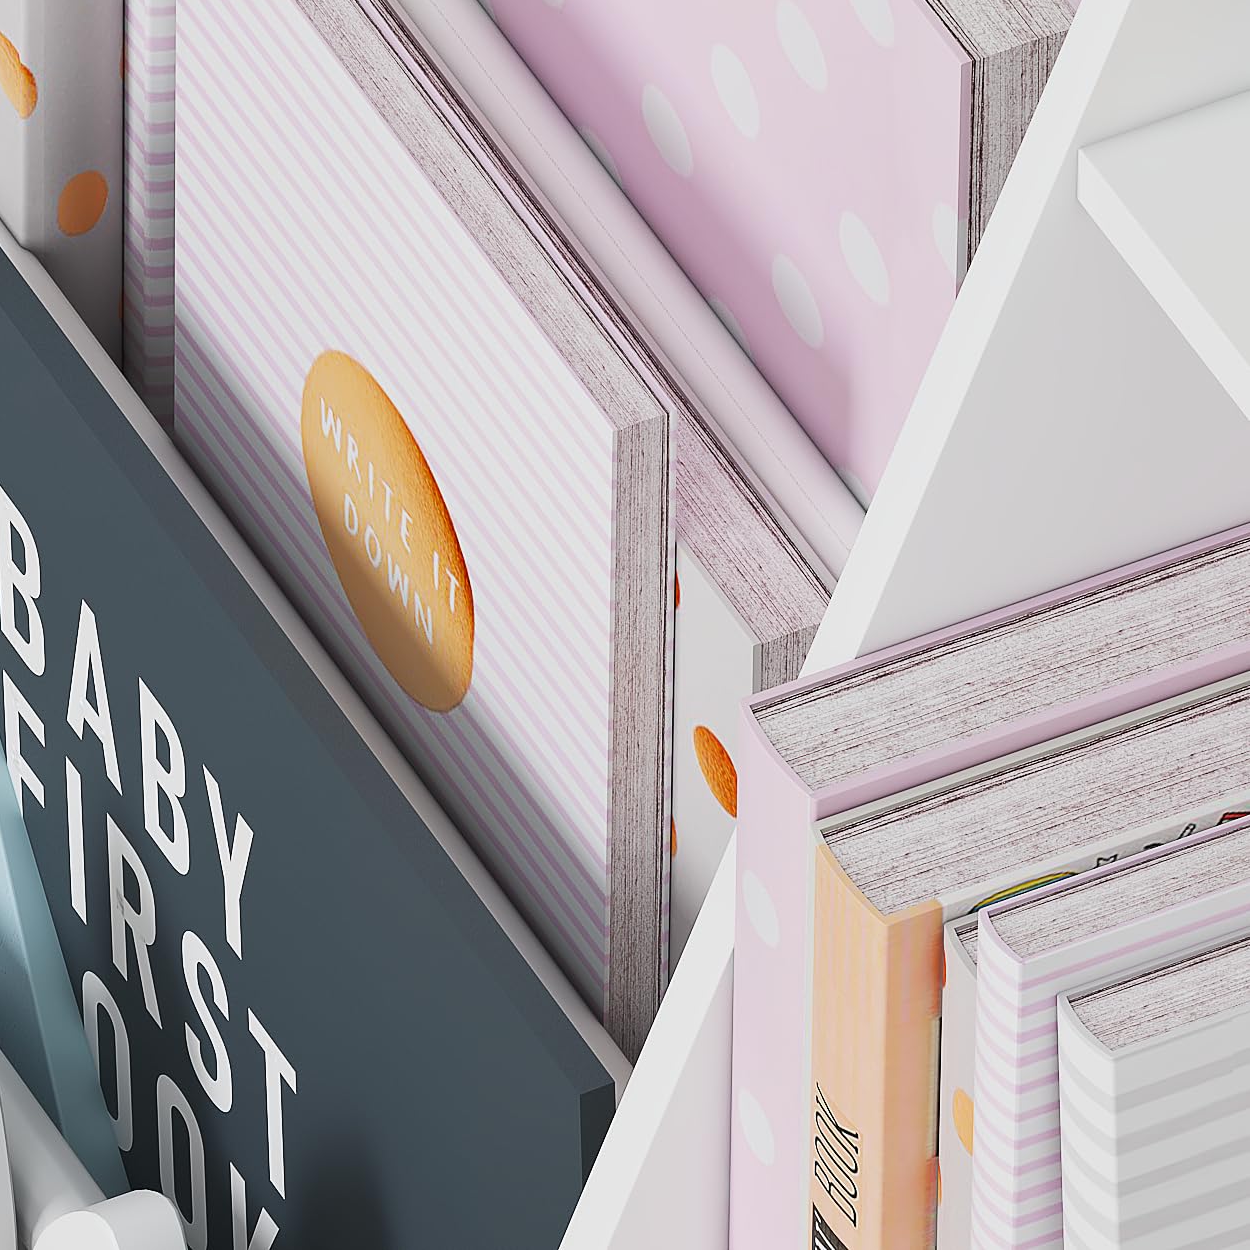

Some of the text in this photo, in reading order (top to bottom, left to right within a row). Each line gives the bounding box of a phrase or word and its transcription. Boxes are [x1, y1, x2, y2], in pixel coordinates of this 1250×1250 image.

[320, 397, 460, 613] WRITE IT
[344, 493, 433, 645] DOWN
[2, 670, 298, 1200] FIRST
[82, 970, 280, 1250] OO
[814, 1081, 859, 1228] BOOK
